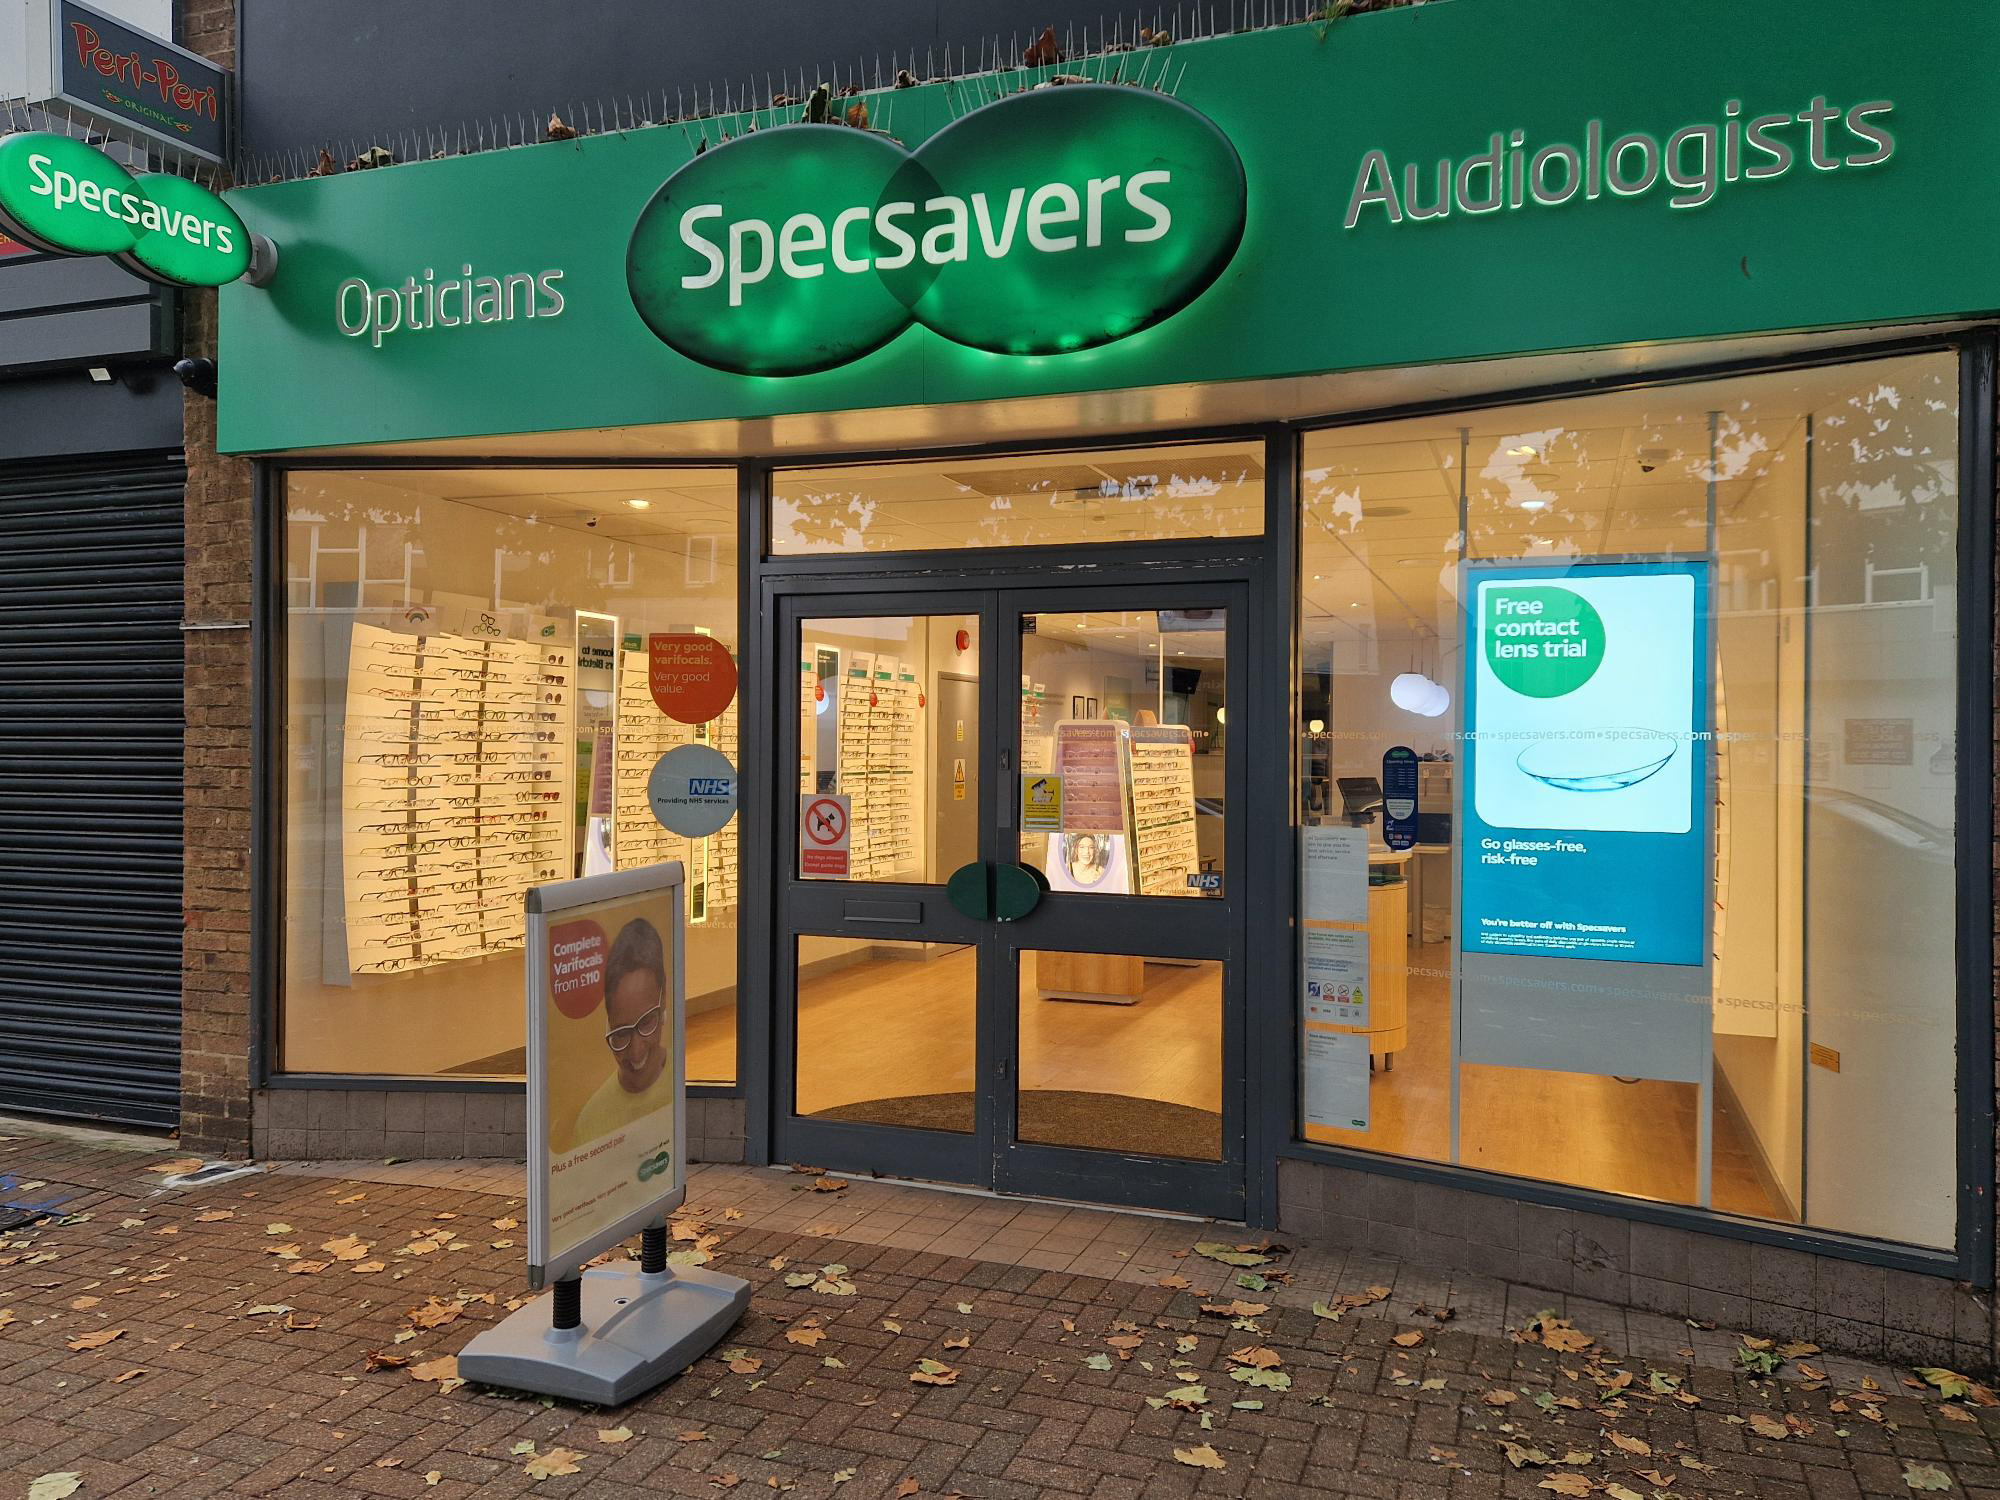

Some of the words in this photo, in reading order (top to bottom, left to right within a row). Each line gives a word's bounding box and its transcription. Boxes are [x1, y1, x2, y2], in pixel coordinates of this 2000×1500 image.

[71, 21, 217, 122] Peri-Peri
[124, 99, 174, 125] ORIGINAL
[1344, 96, 1895, 229] Audiologists
[28, 153, 234, 254] Specsavers
[679, 169, 1173, 306] Specsavers
[335, 264, 566, 348] Opticians
[1495, 597, 1544, 615] Free
[1494, 618, 1580, 637] contact
[654, 641, 681, 655] Very
[684, 641, 713, 653] good
[1495, 640, 1539, 658] lens
[1543, 639, 1587, 658] trial
[654, 653, 713, 666] varifocals.
[653, 671, 679, 683] Very
[681, 671, 710, 683] good
[654, 683, 684, 694] value.
[1498, 729, 1595, 741] specsavers.com
[1604, 729, 1711, 742] specsavers.com
[690, 779, 729, 795] NHS
[657, 797, 687, 805] Providing
[704, 797, 729, 805] services
[1481, 838, 1500, 850] Go
[1503, 839, 1587, 853] glasses-free,
[1481, 853, 1538, 866] risk-free
[1188, 874, 1219, 888] NHS
[1481, 918, 1508, 927] You're
[1509, 919, 1538, 928] better
[1539, 921, 1553, 930] off
[1554, 921, 1575, 931] with
[1576, 923, 1627, 934] Specsavers
[553, 935, 601, 957] Complete
[554, 951, 603, 976] Varifocals
[554, 976, 579, 995] from
[580, 970, 600, 987] £110
[551, 1164, 567, 1175] Plus
[567, 1160, 573, 1168] a
[573, 1153, 589, 1167] free
[589, 1140, 613, 1158] second
[613, 1134, 626, 1148] pair
